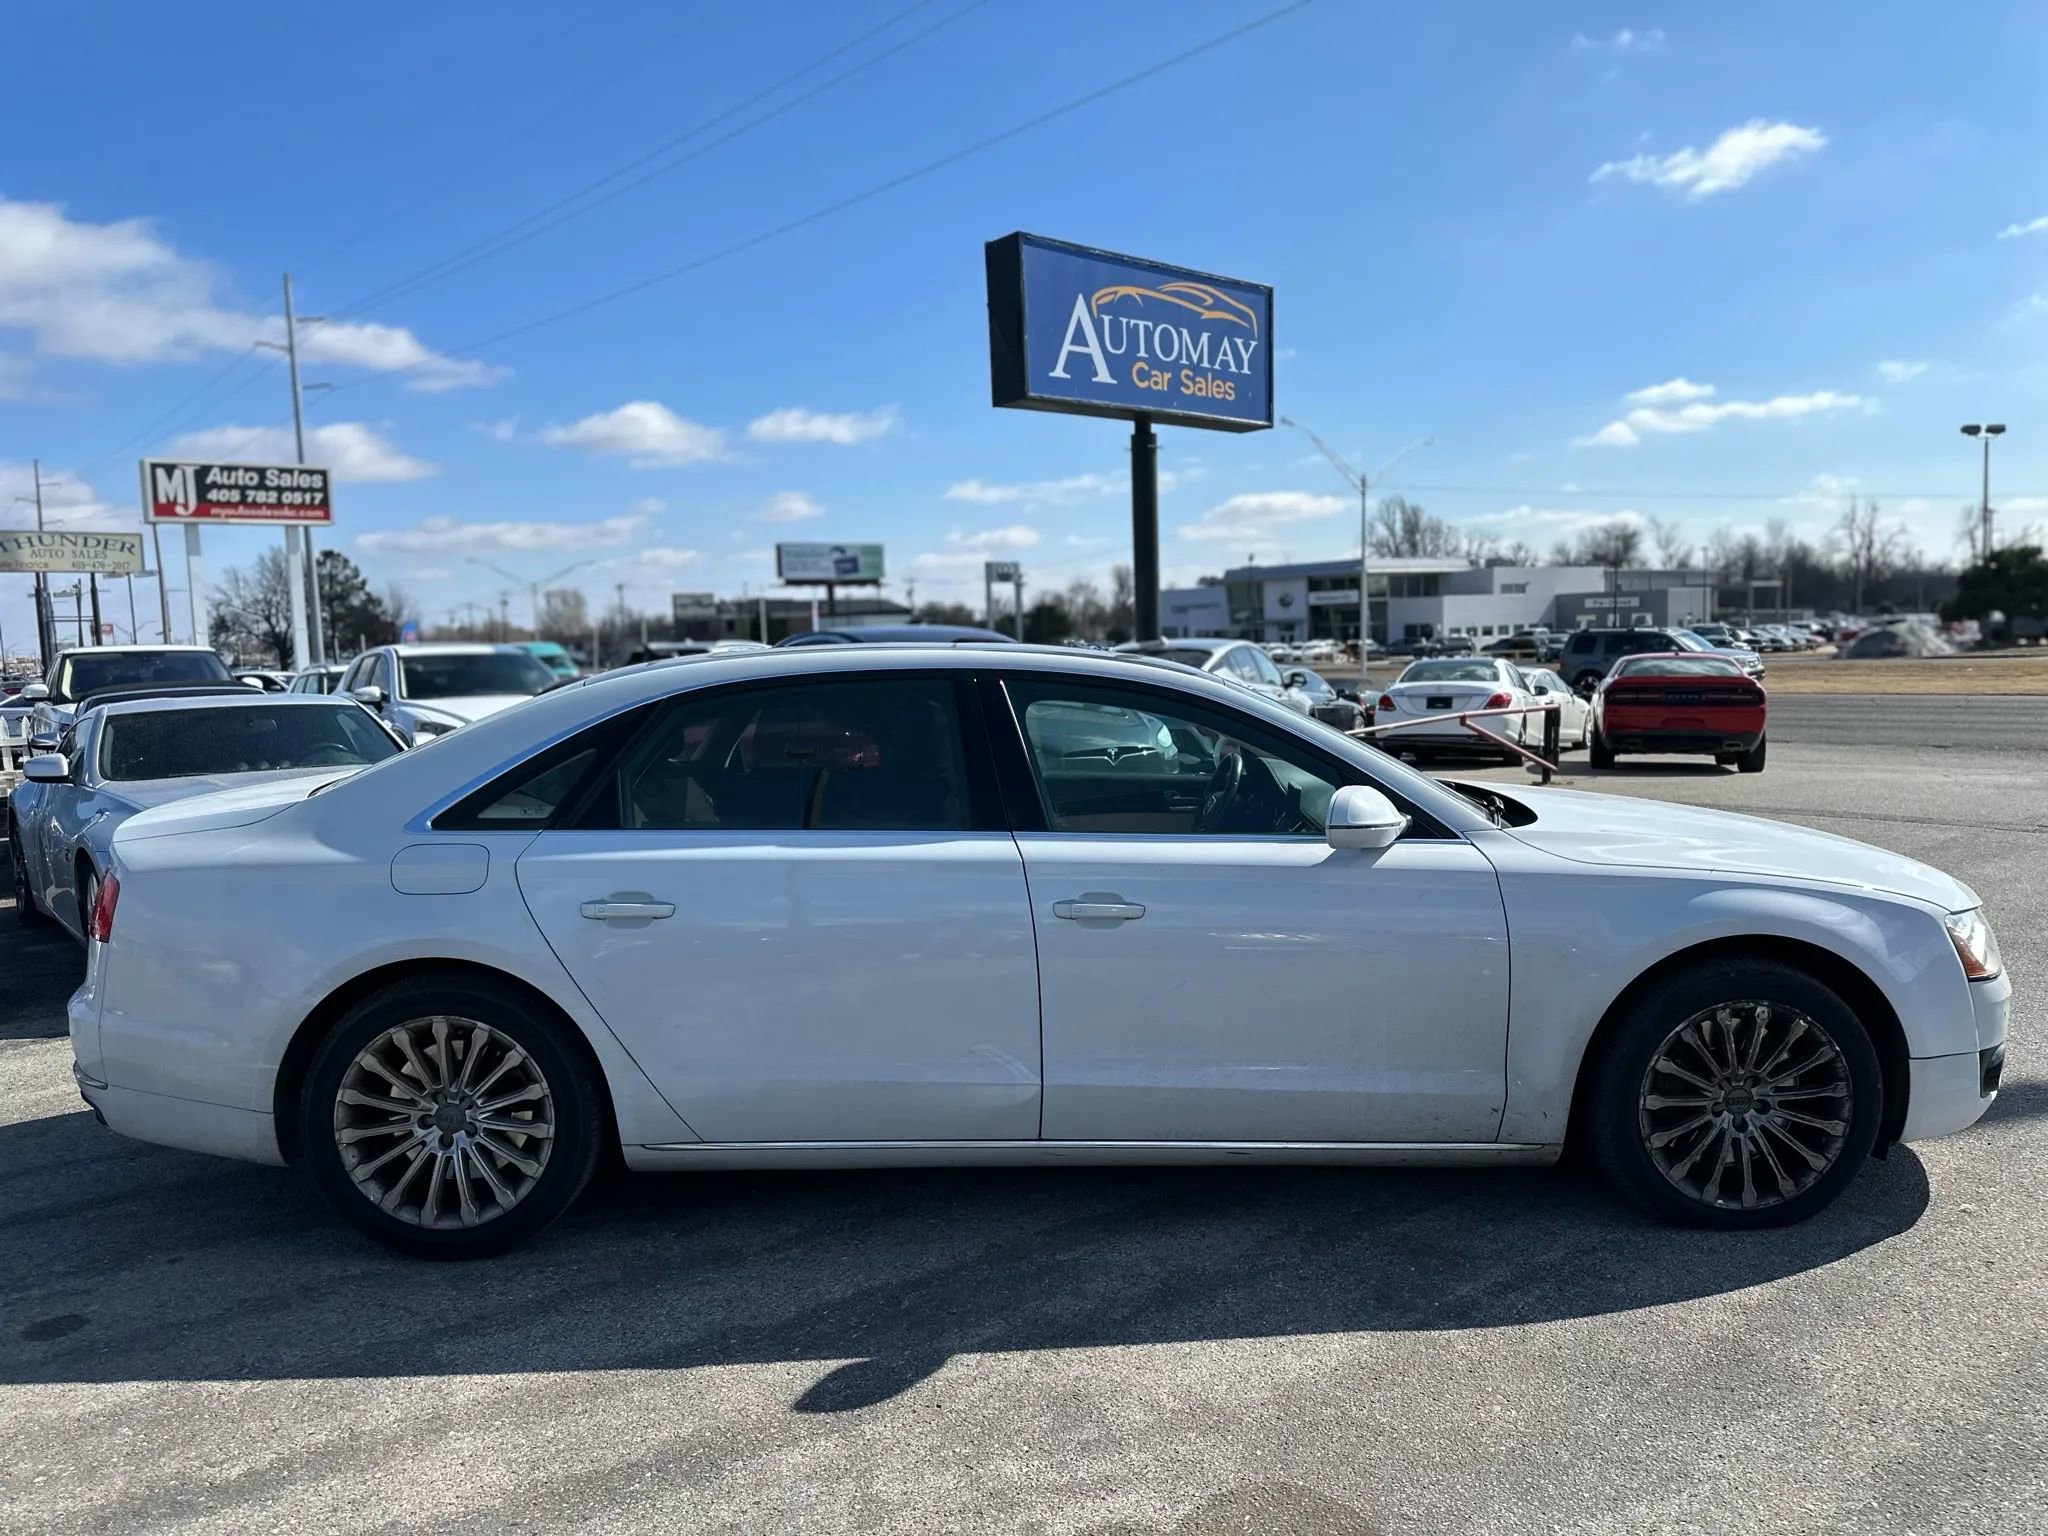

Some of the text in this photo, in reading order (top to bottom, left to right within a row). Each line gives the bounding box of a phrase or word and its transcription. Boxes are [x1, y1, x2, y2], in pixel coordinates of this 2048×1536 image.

[1049, 293, 1257, 384] AUTOMAY
[1132, 362, 1236, 401] Car Sales
[205, 467, 323, 489] Auto Sales
[155, 464, 200, 516] MJ
[206, 488, 324, 506] 405 782 0517
[0, 534, 136, 556] THUNDER
[30, 549, 108, 560] AUTO SALES
